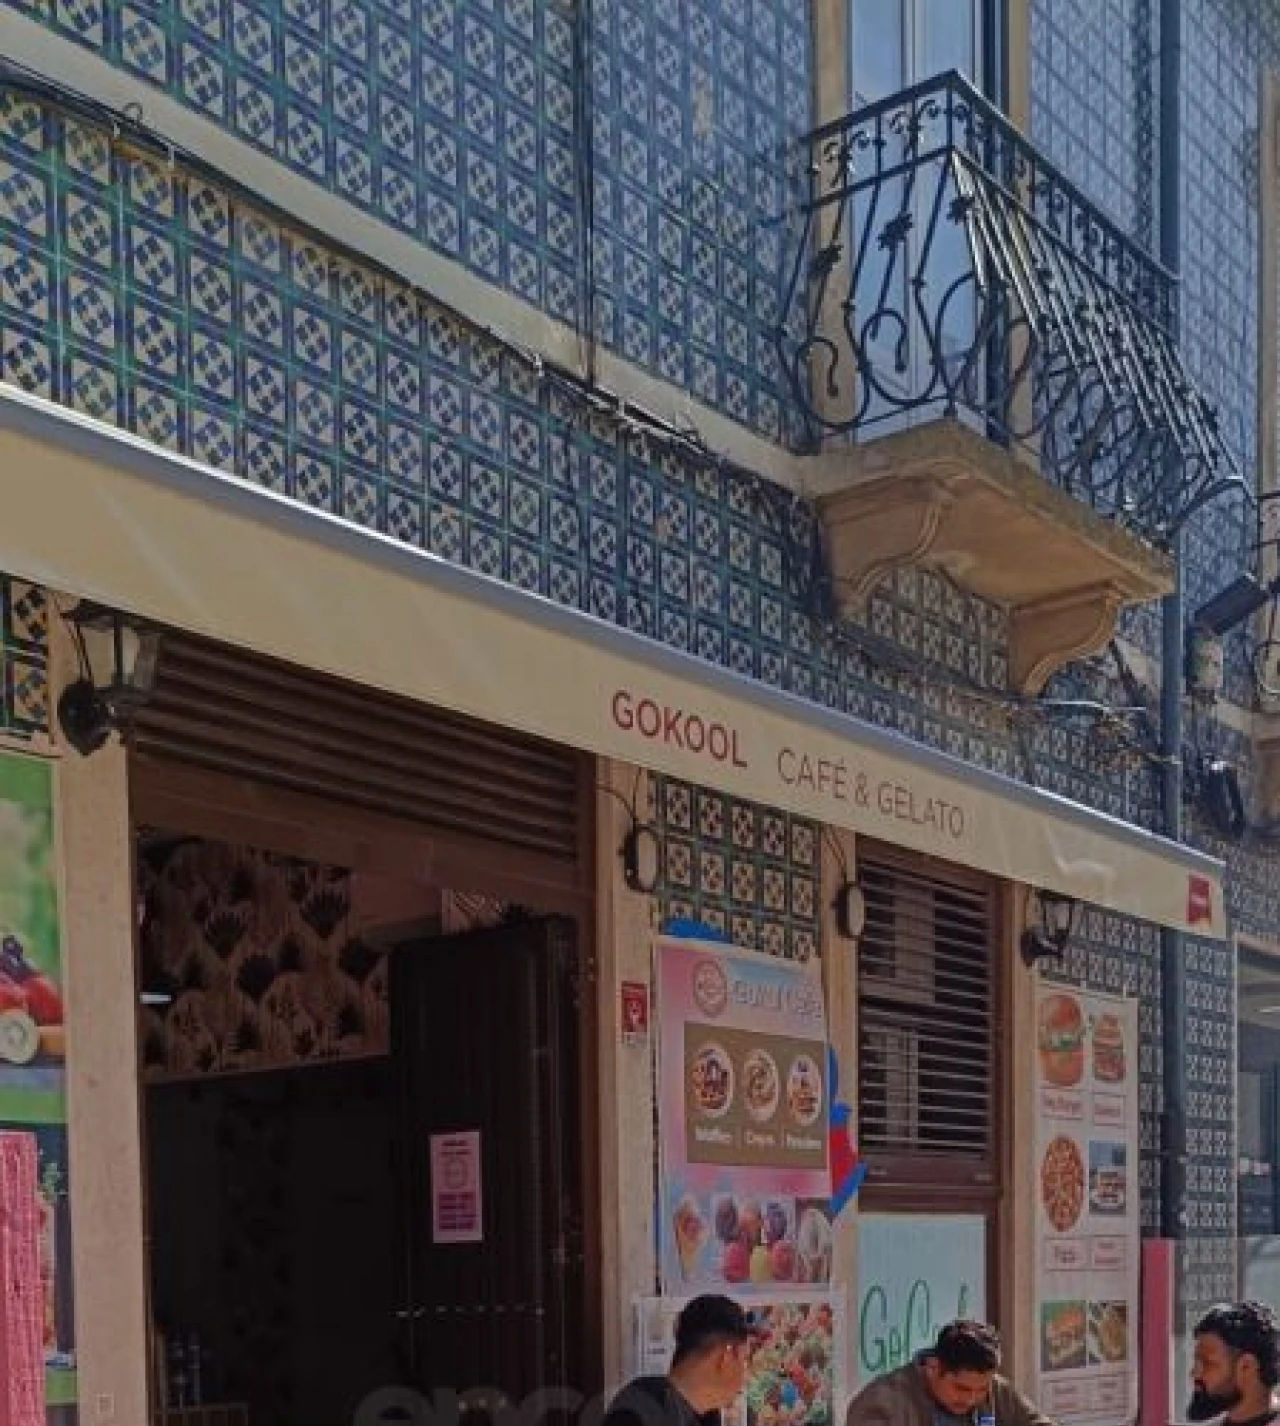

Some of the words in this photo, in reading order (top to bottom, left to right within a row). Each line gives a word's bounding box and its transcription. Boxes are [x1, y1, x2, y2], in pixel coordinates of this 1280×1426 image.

[611, 689, 748, 768] GOKOOL
[777, 746, 848, 801] CAFÉ
[854, 772, 871, 807] &
[876, 782, 965, 839] GELATO
